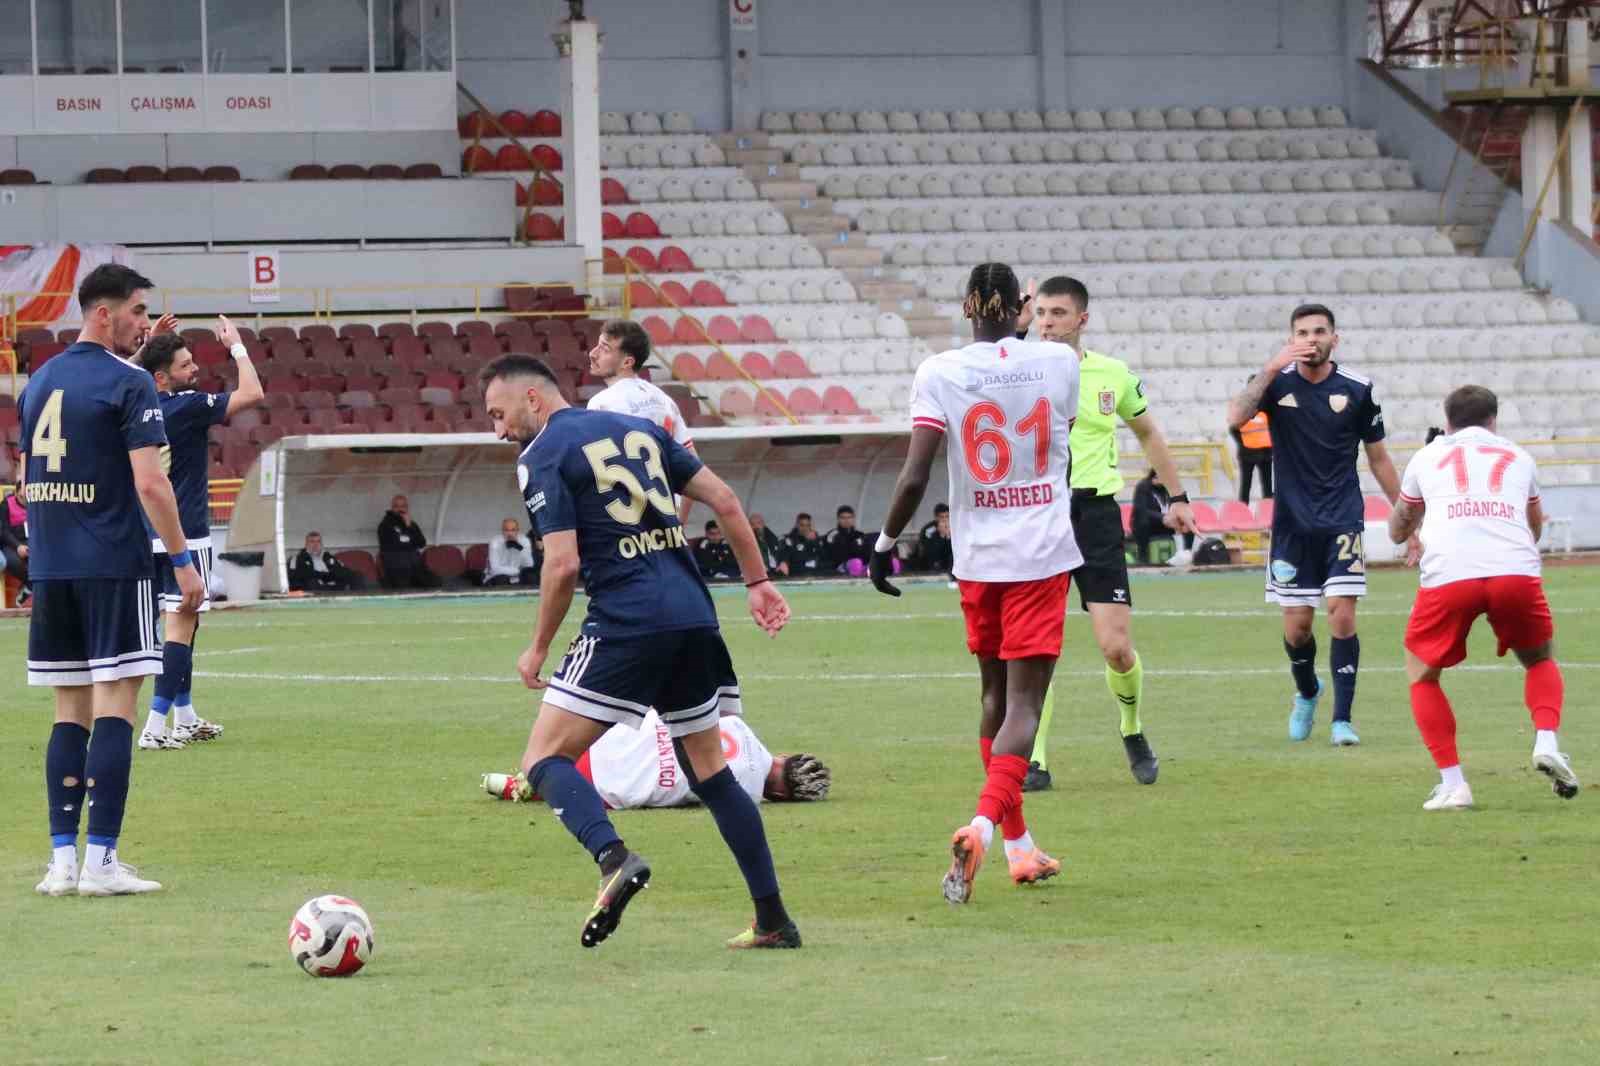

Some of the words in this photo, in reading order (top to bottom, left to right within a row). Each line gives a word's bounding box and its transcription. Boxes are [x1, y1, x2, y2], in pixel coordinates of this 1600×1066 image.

[56, 98, 102, 112] BASIN
[130, 97, 196, 112] ÇALIŞMA
[226, 96, 272, 110] ODASI
[255, 256, 275, 284] B
[32, 390, 67, 472] 4
[961, 396, 1053, 484] 61
[582, 430, 676, 525] 53
[1437, 446, 1516, 493] 17
[974, 484, 1053, 508] RASHEED
[1336, 533, 1361, 560] 24
